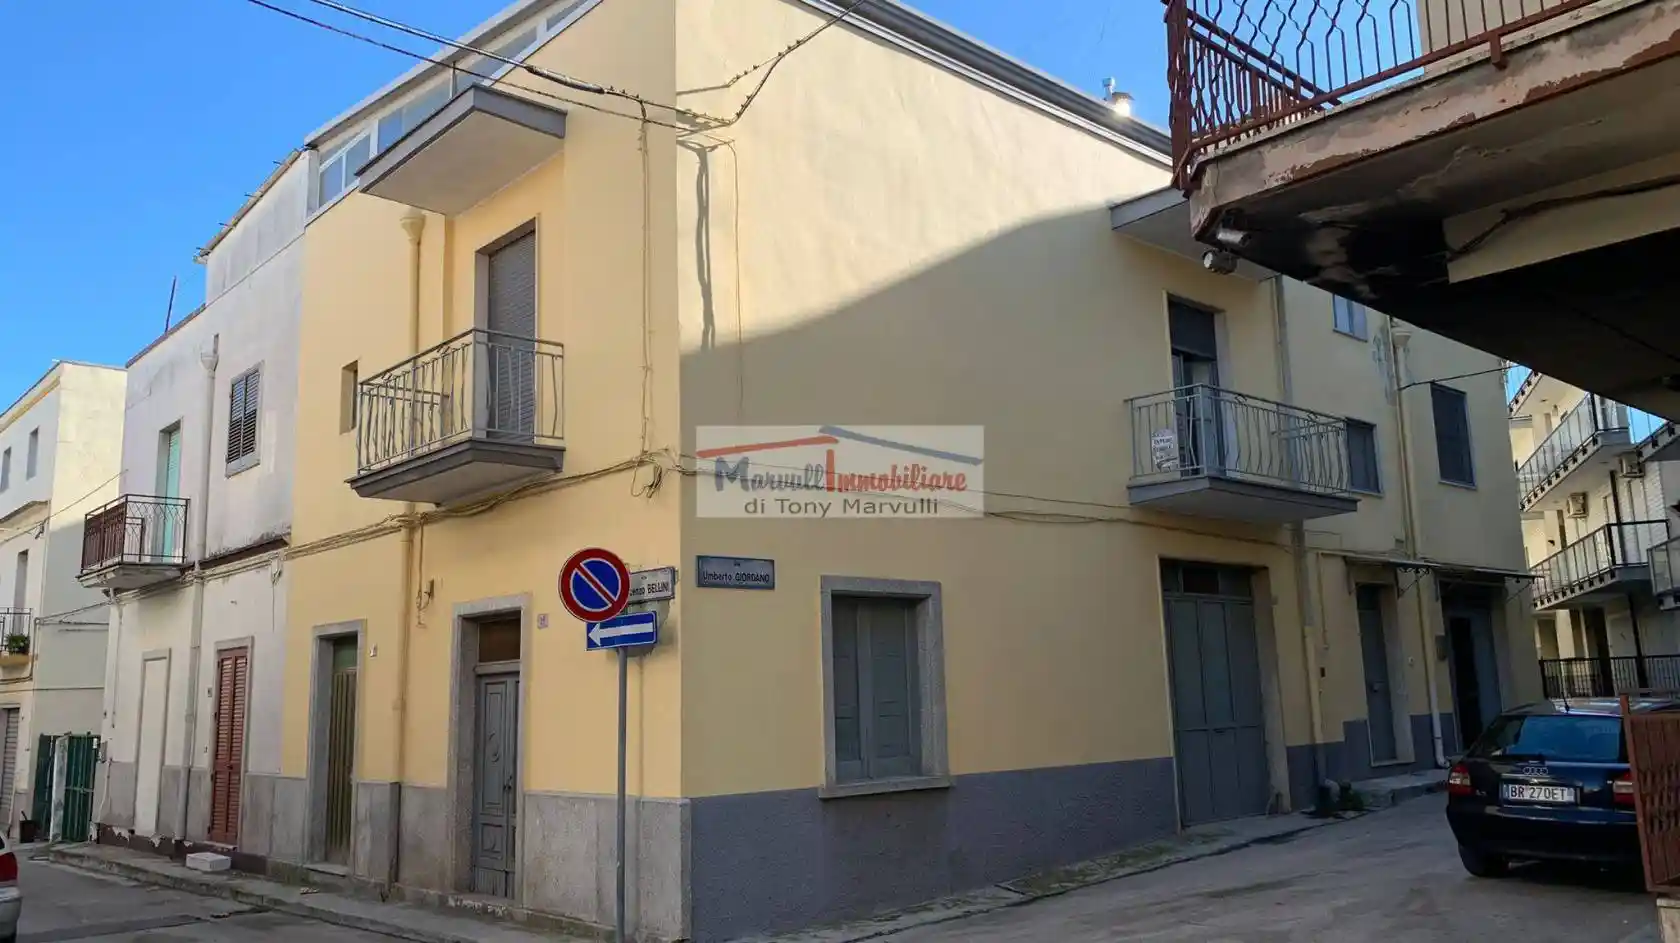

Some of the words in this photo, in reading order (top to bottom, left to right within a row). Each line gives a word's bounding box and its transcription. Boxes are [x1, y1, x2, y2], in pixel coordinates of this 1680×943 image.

[703, 570, 732, 581] Umberto
[735, 572, 770, 583] GIORDANO
[1510, 786, 1525, 798] BR
[1529, 786, 1566, 800] 270ET
